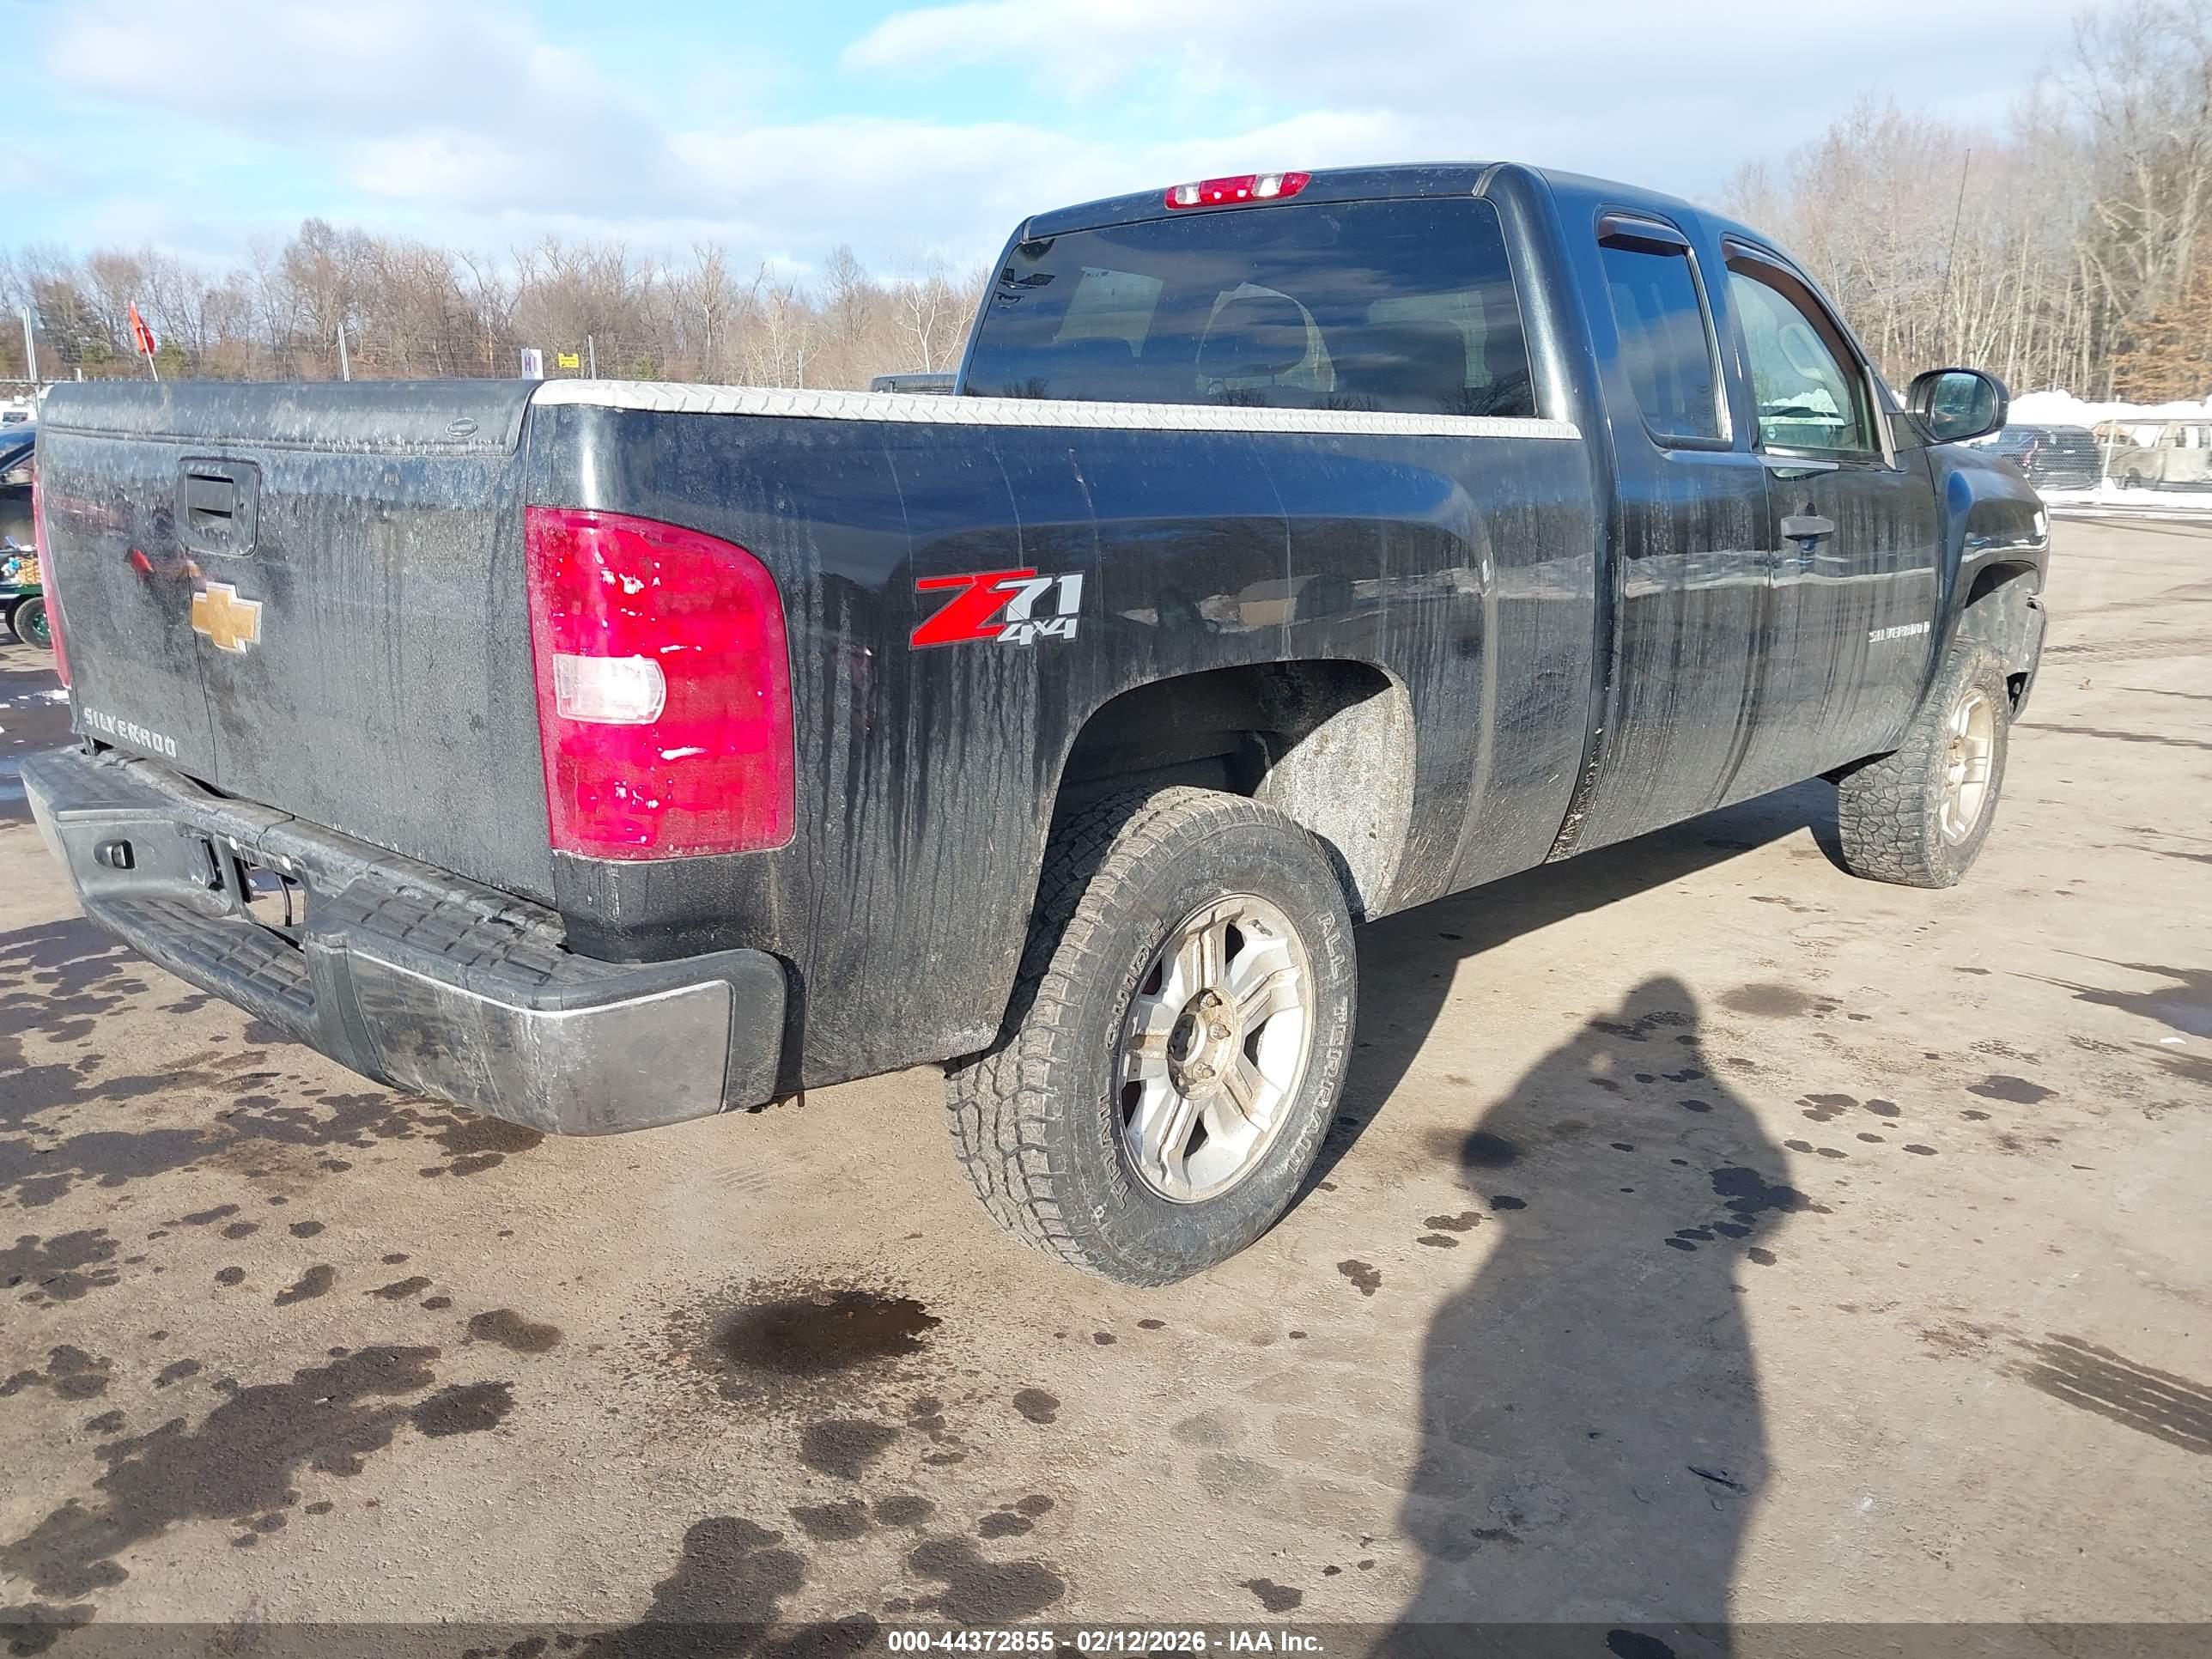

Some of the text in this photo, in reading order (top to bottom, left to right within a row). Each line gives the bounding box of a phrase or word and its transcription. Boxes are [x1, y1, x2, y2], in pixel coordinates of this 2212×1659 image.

[910, 567, 1085, 649] Z71
[83, 707, 177, 758] SILVERADO
[1318, 913, 1346, 979] ALL
